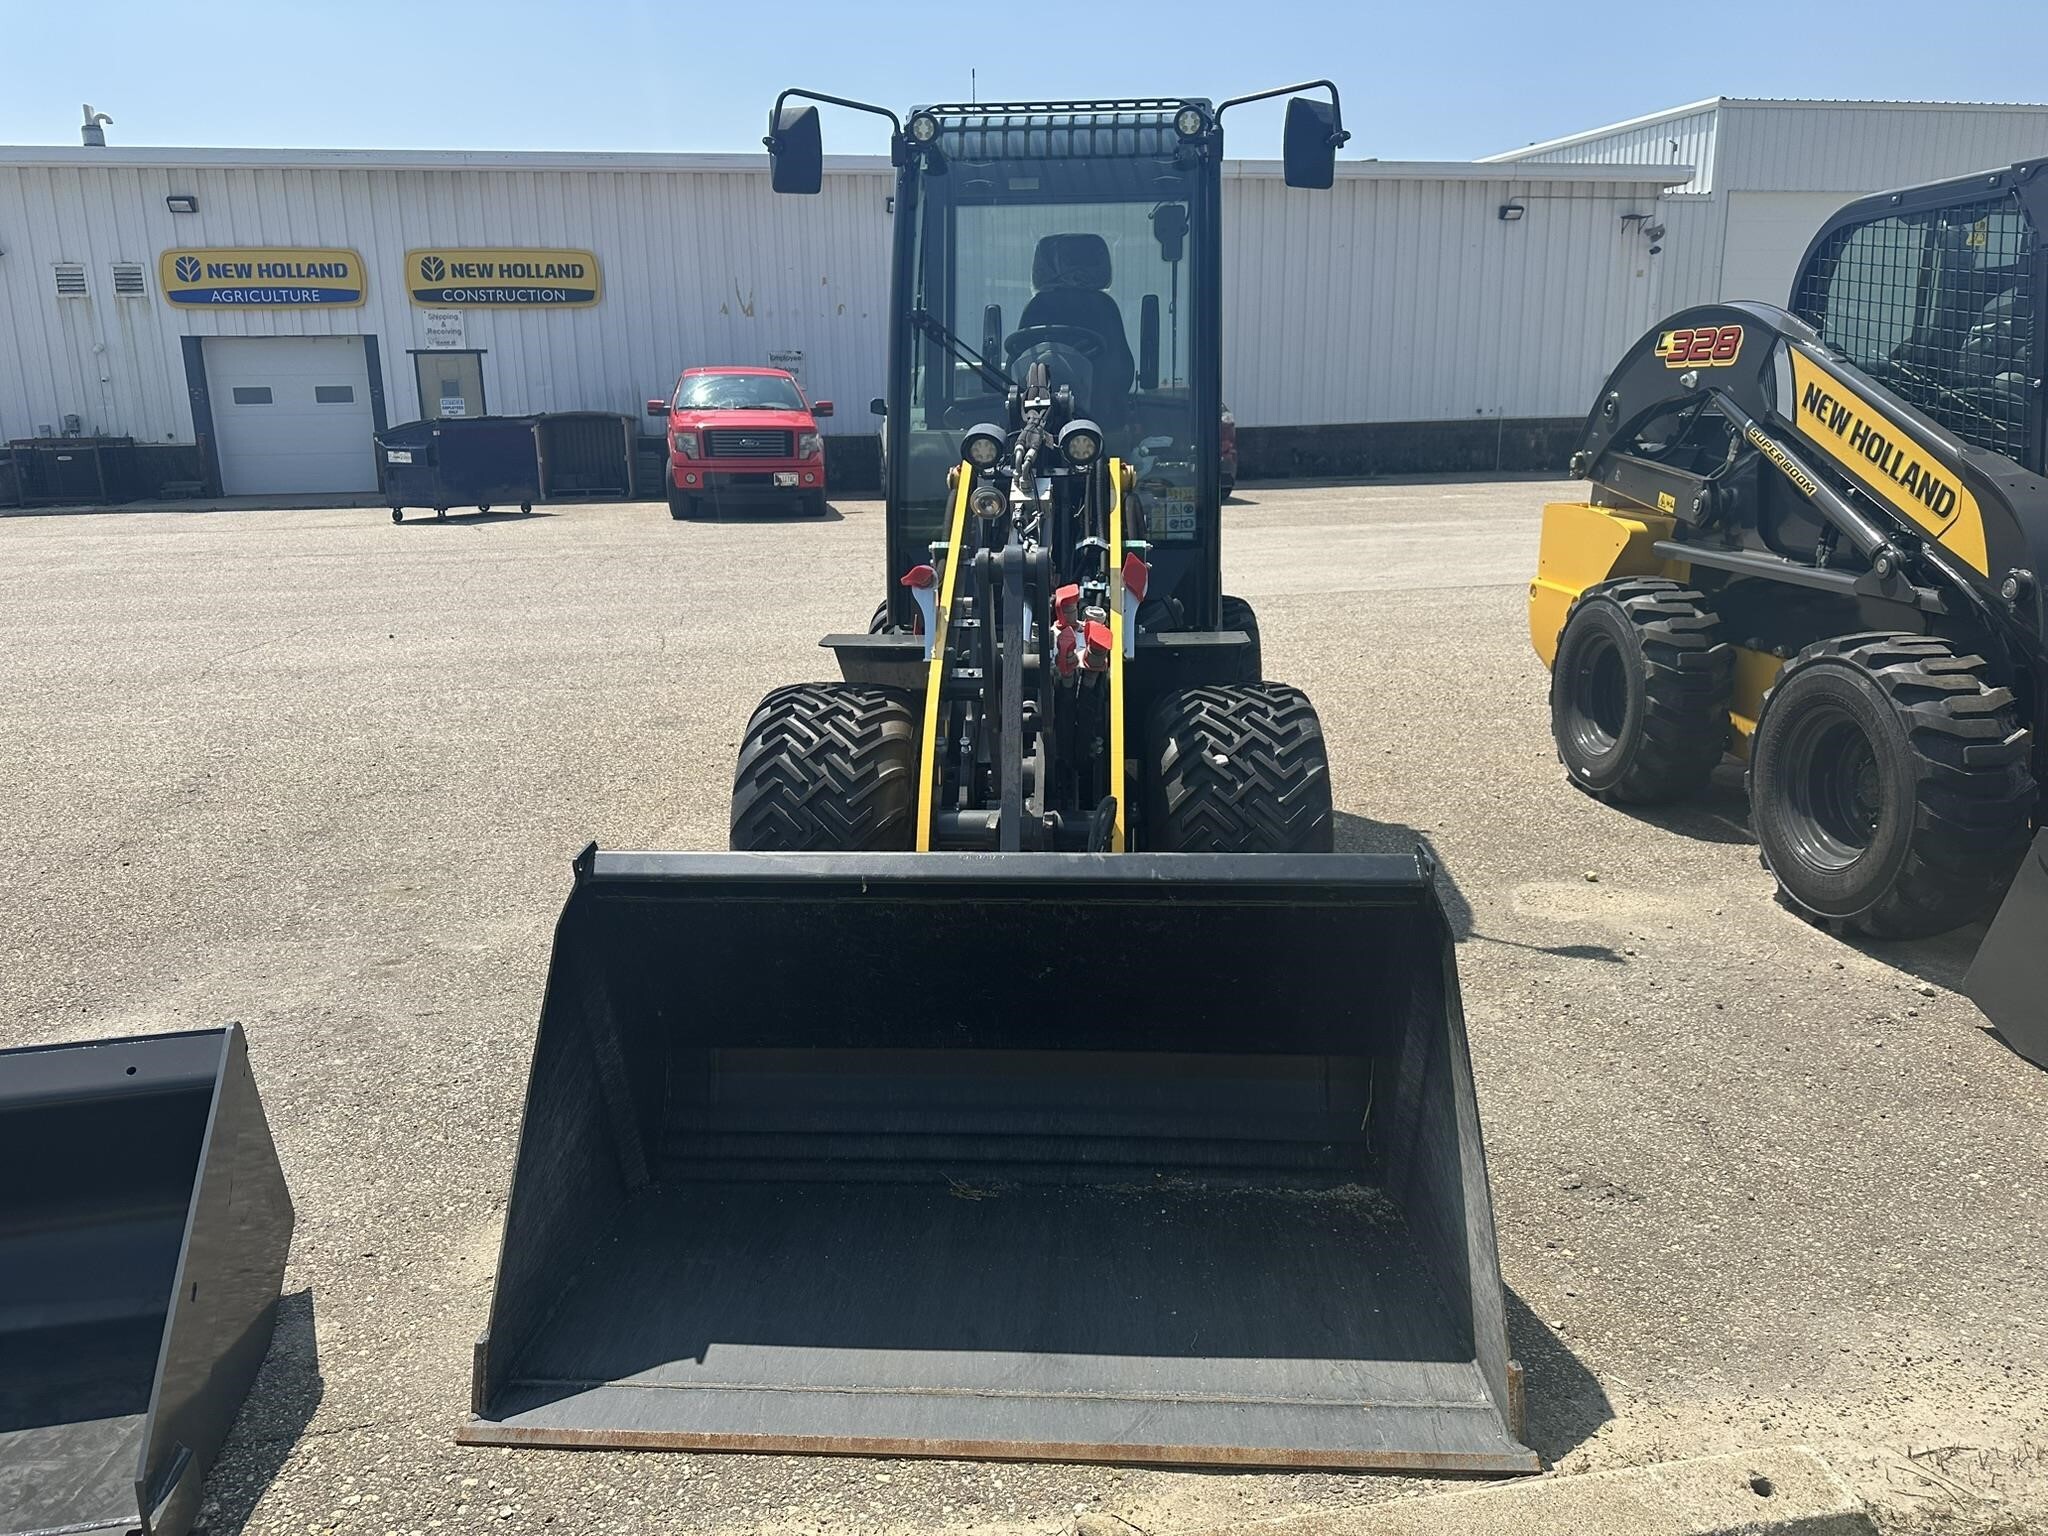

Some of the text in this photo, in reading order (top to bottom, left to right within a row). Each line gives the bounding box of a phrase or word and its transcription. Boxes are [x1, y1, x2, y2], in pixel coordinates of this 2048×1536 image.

[207, 263, 348, 279] NEW HOLLAND
[450, 263, 585, 279] NEW HOLLAND
[211, 290, 321, 302] AGRICULTURE
[442, 289, 566, 302] CONSTRUCTION
[428, 313, 459, 321] Shipping
[427, 328, 462, 336] Receiving
[1655, 325, 1744, 368] L328
[1801, 381, 1956, 519] NEW HOLLAND
